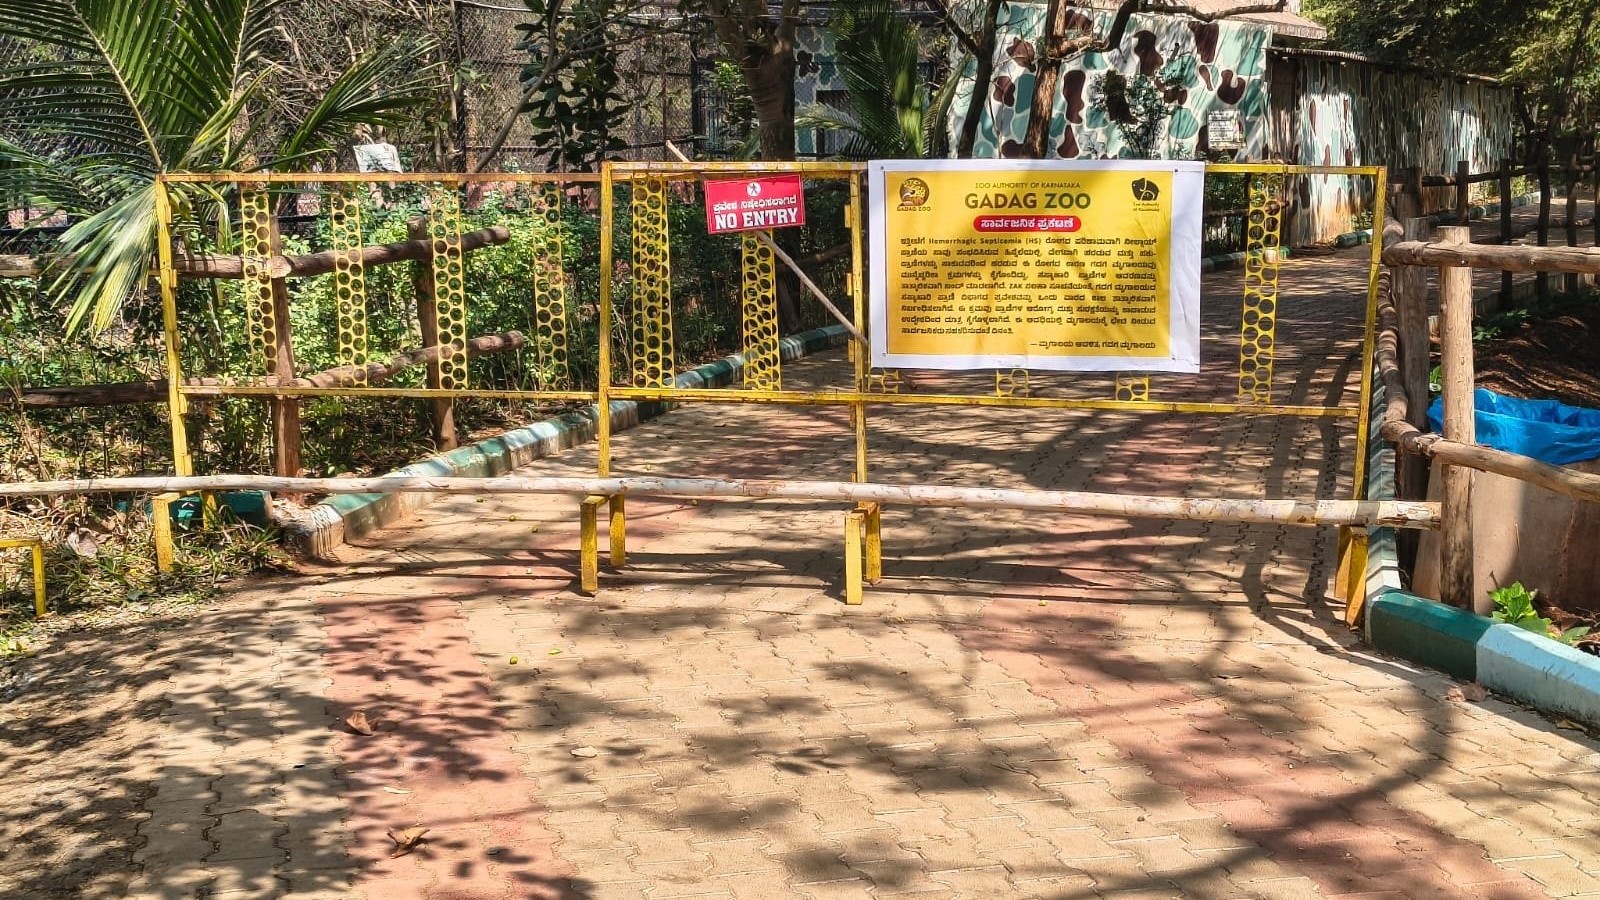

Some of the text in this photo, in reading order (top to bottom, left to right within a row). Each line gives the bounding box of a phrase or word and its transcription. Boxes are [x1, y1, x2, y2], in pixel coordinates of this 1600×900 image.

[965, 193, 1091, 209] GADAG ZOO
[715, 207, 798, 230] NO ENTRY
[981, 218, 1074, 230] ಸಾರ್ವಜನಿಕ ಪ್ರಕಟಣೆ
[929, 237, 976, 245] Hemorrhagic
